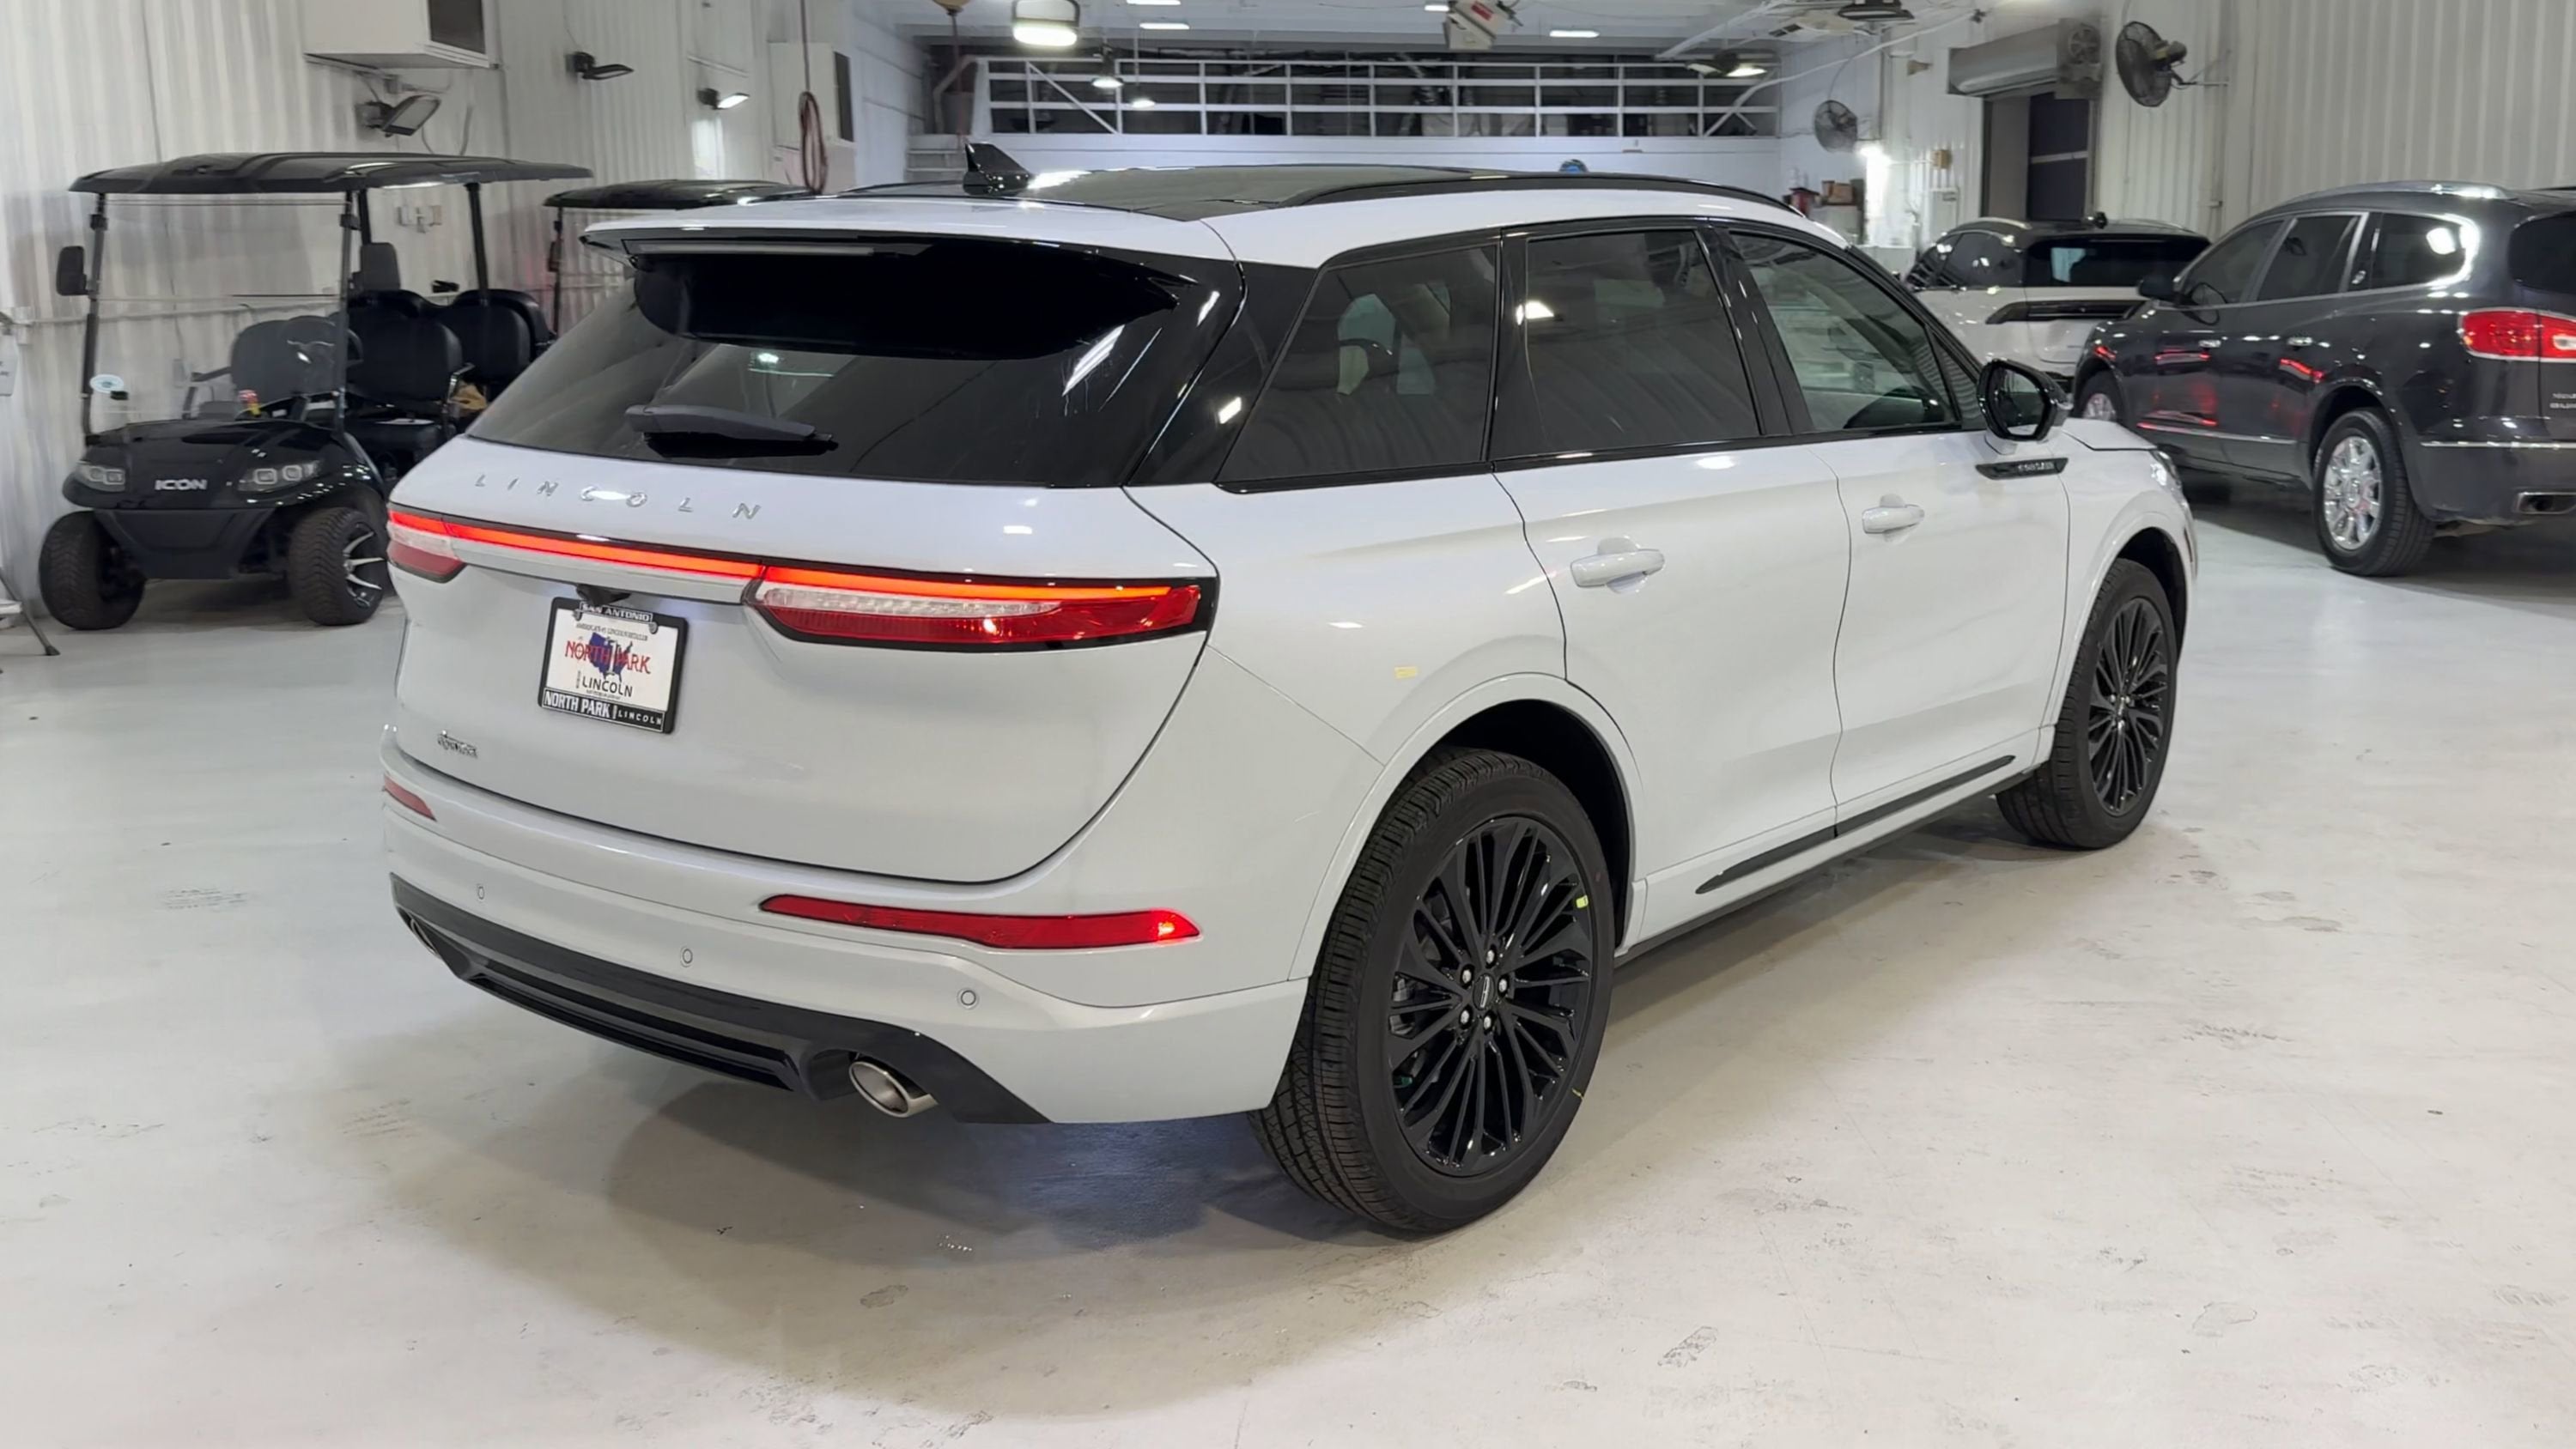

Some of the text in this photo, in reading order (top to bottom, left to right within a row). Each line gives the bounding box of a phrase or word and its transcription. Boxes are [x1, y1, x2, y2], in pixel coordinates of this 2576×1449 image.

[155, 479, 208, 490] ICON
[475, 474, 761, 520] LINCOLN
[605, 608, 650, 621] ANTONIO
[564, 640, 651, 674] NORTH PARK
[582, 676, 633, 697] LINCOLN
[544, 690, 579, 712] NORTH
[580, 698, 611, 718] PARK
[618, 710, 662, 725] LINCOLN
